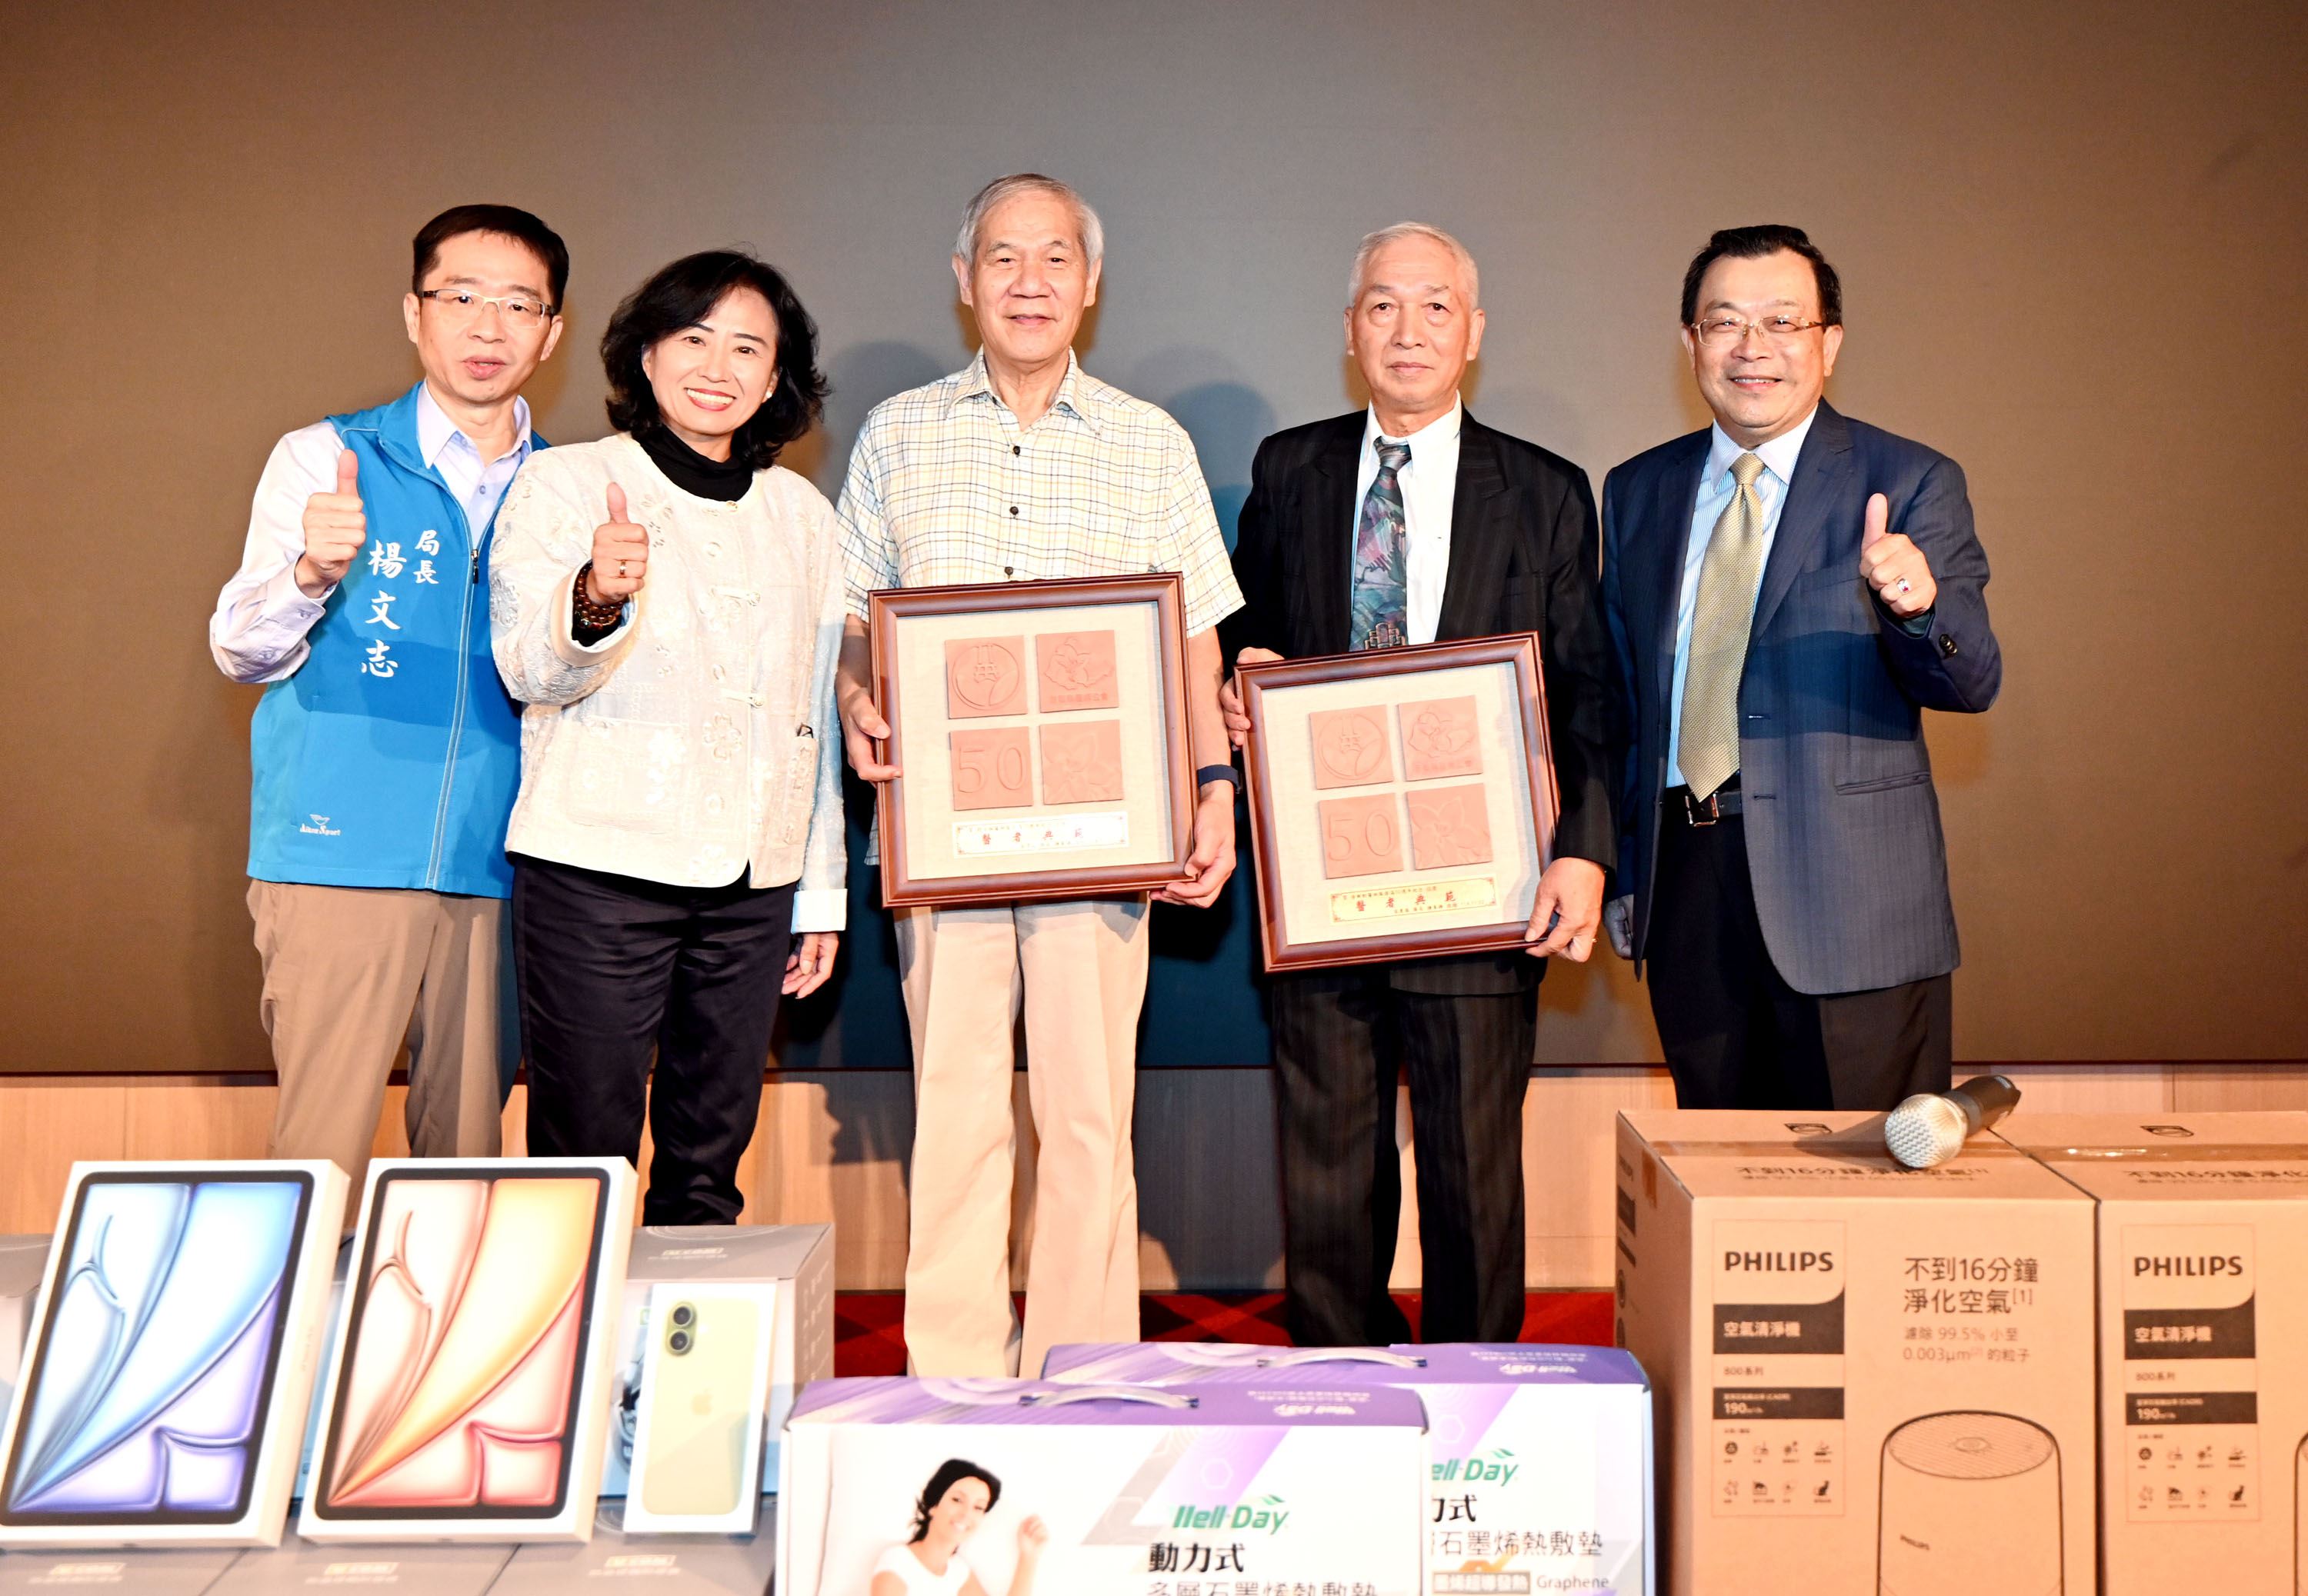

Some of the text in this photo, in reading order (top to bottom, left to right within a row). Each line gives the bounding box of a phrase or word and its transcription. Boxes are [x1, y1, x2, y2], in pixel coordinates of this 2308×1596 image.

[414, 529, 440, 585] 局長
[361, 539, 407, 678] 楊文志
[957, 743, 1025, 795] 50
[1327, 809, 1395, 862] 50
[1725, 1251, 1834, 1271] PHILIPS
[1904, 1256, 2039, 1283] 不到16分鐘
[2134, 1255, 2244, 1277] PHILIPS
[1903, 1288, 2033, 1314] 淨化空氣[1]
[1432, 1530, 1604, 1557] 石墨烯熱敷墊
[1148, 1541, 1246, 1574] 動力式
[1536, 1575, 1611, 1592] Graphene
